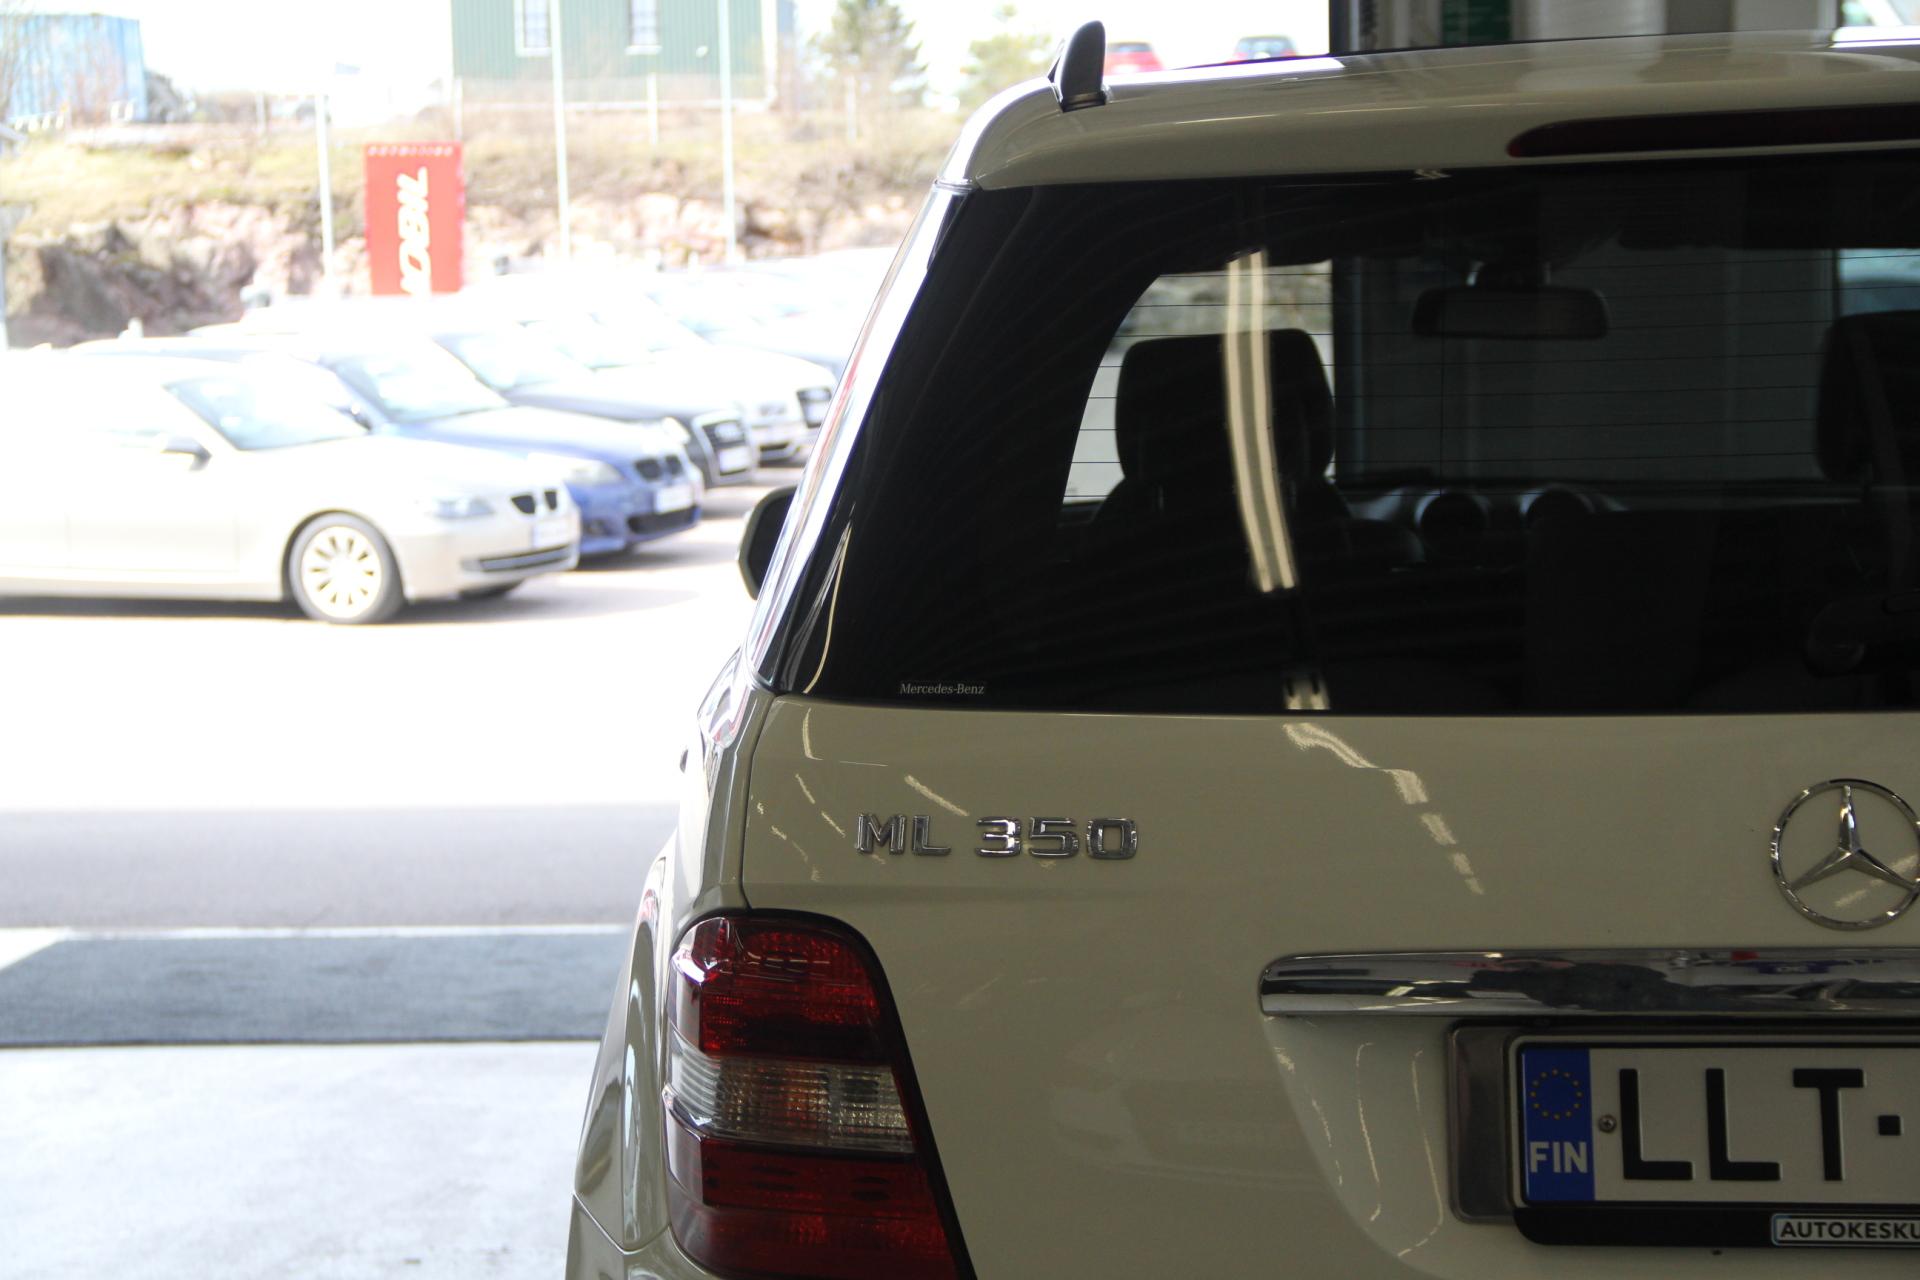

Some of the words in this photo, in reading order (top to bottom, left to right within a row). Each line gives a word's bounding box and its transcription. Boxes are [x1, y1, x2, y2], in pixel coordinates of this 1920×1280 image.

[900, 682, 985, 695] Mercedes-Benz
[855, 813, 951, 855] ML
[975, 815, 1138, 860] 350
[1529, 1141, 1588, 1174] FIN
[1780, 1221, 1920, 1239] AUTOKESKU
